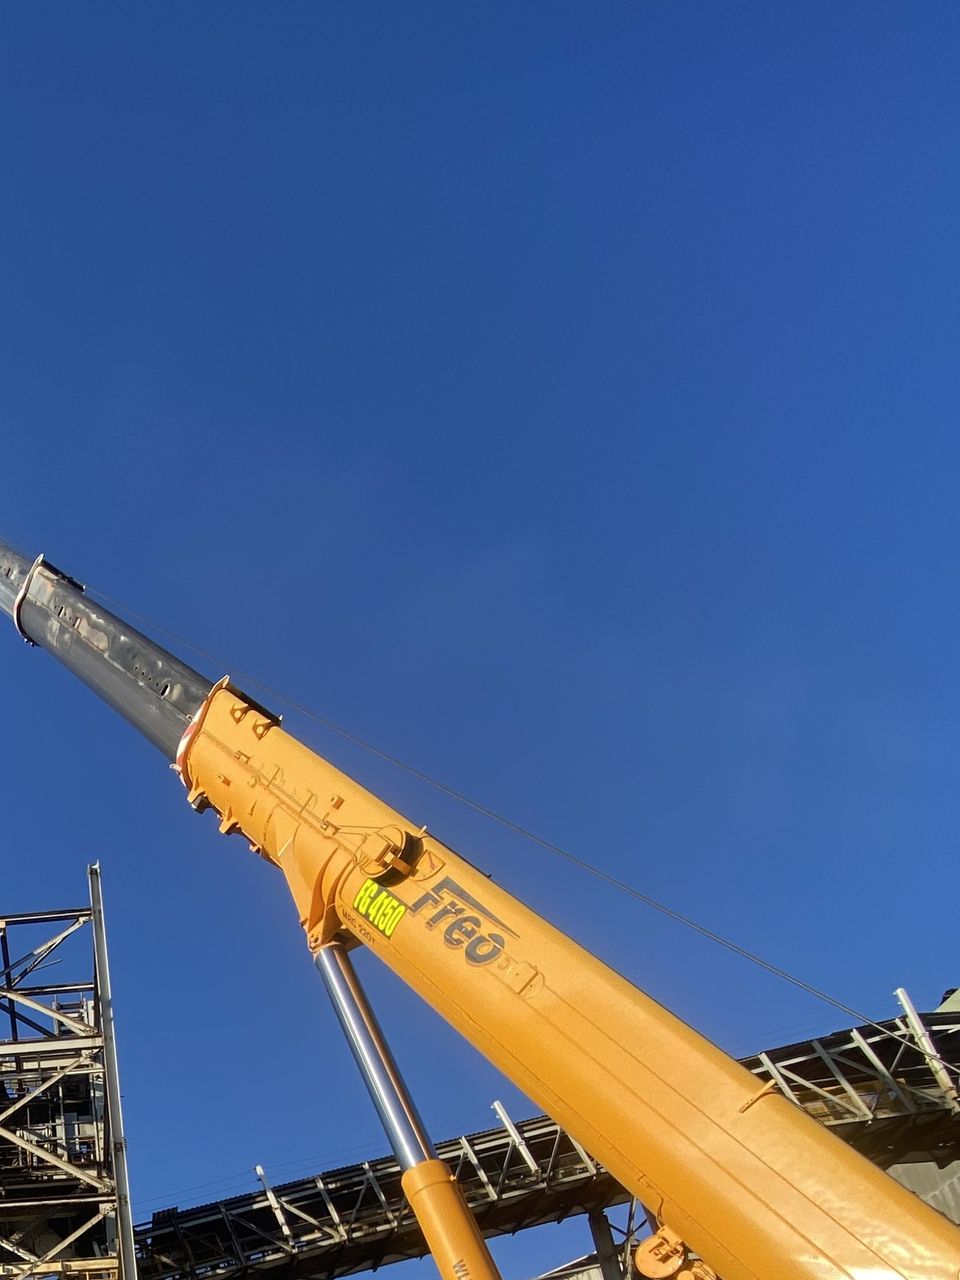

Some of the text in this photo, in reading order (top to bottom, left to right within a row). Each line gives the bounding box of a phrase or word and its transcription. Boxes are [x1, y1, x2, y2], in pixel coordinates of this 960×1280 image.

[353, 879, 407, 937] FG 4150
[409, 876, 521, 967] Freo
